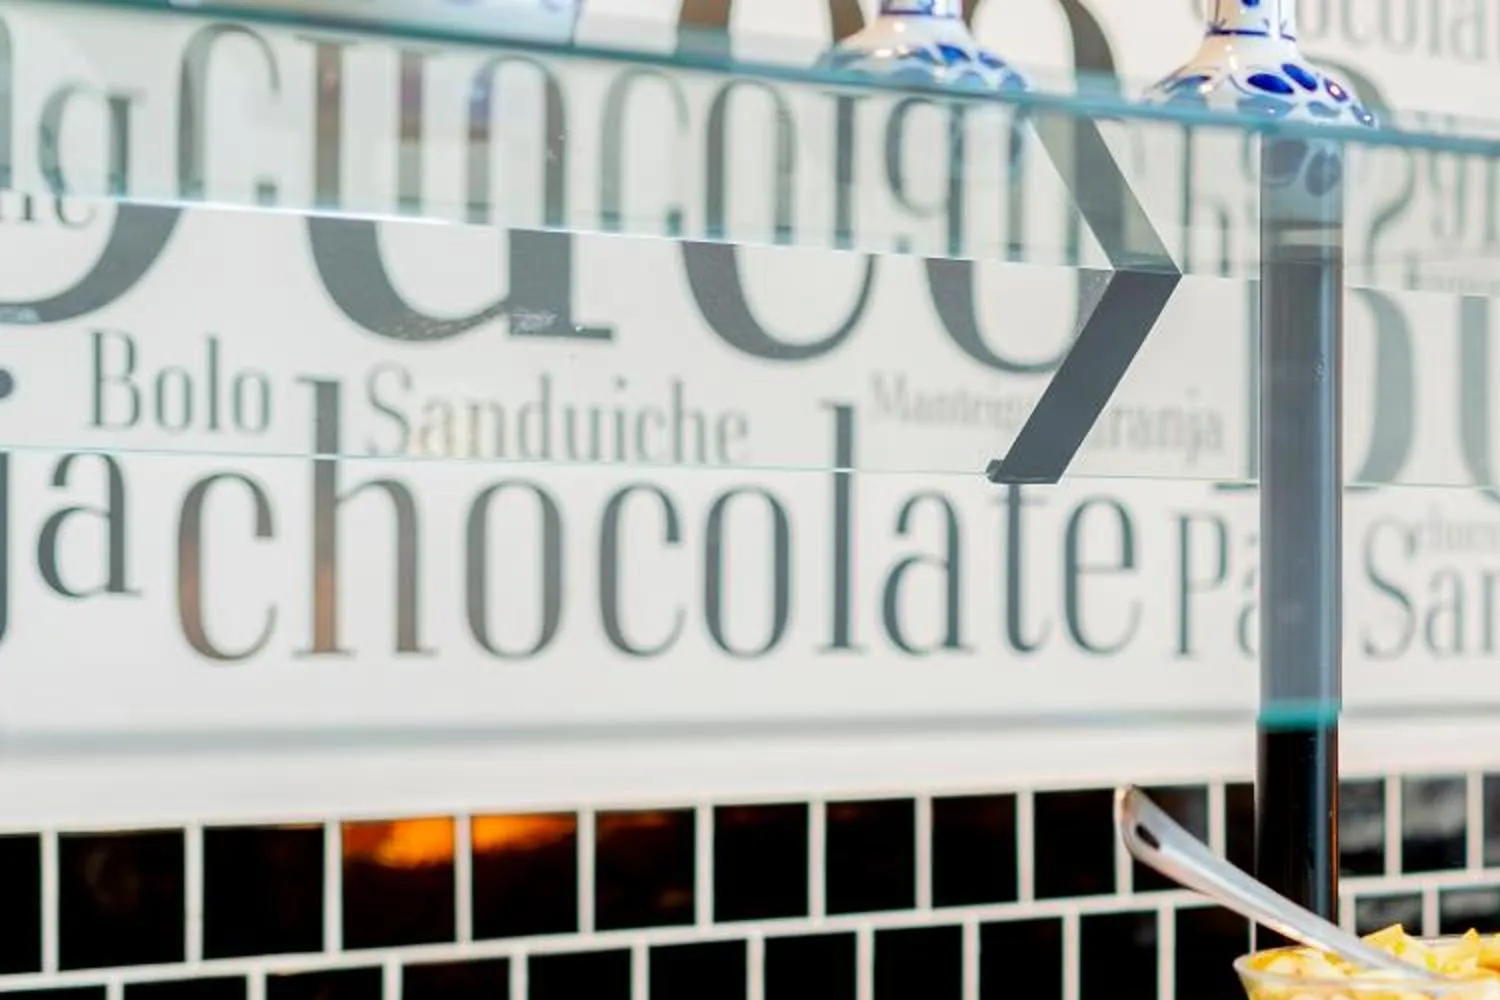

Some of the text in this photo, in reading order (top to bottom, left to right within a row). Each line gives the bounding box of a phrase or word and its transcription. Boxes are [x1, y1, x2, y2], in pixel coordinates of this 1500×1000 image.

[86, 330, 272, 434] Bolo
[364, 361, 749, 466] Sanduiche
[176, 376, 1142, 662] chocolate
